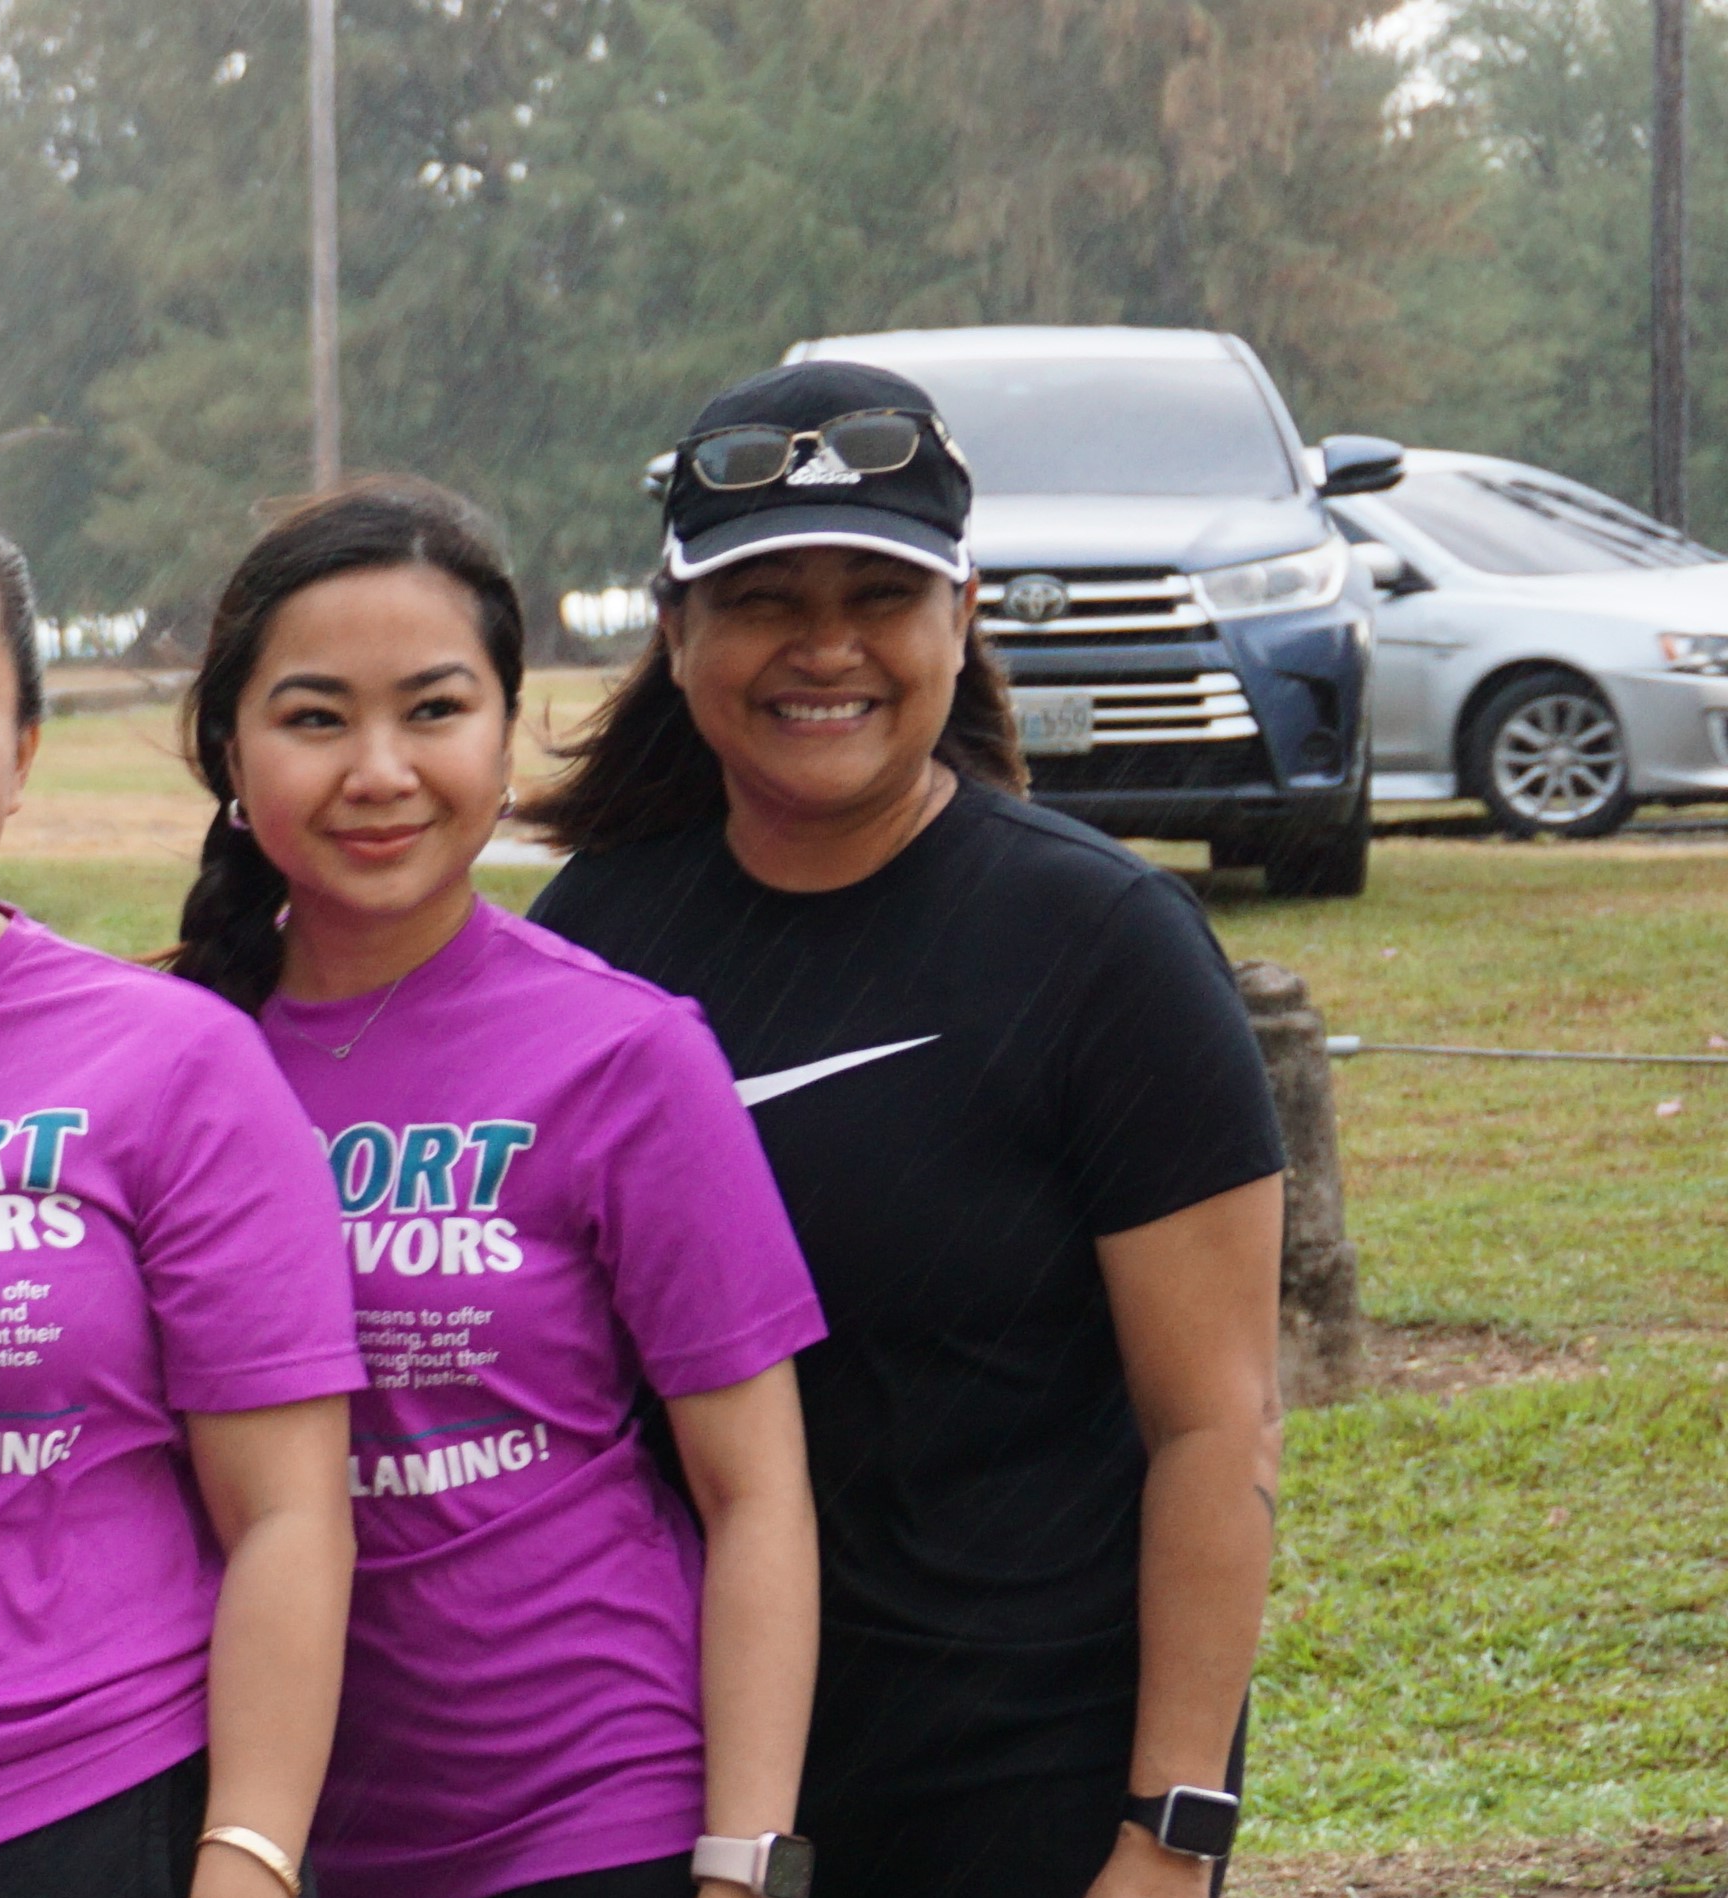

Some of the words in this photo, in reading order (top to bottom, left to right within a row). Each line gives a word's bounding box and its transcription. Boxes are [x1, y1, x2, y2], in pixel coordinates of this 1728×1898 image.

[2, 1280, 52, 1301] offer
[420, 1308, 443, 1327] to
[446, 1306, 495, 1326] offer
[14, 1322, 64, 1345] their
[431, 1318, 471, 1347] and
[457, 1348, 500, 1368] their
[375, 1369, 411, 1389] and
[414, 1368, 484, 1390] justice.
